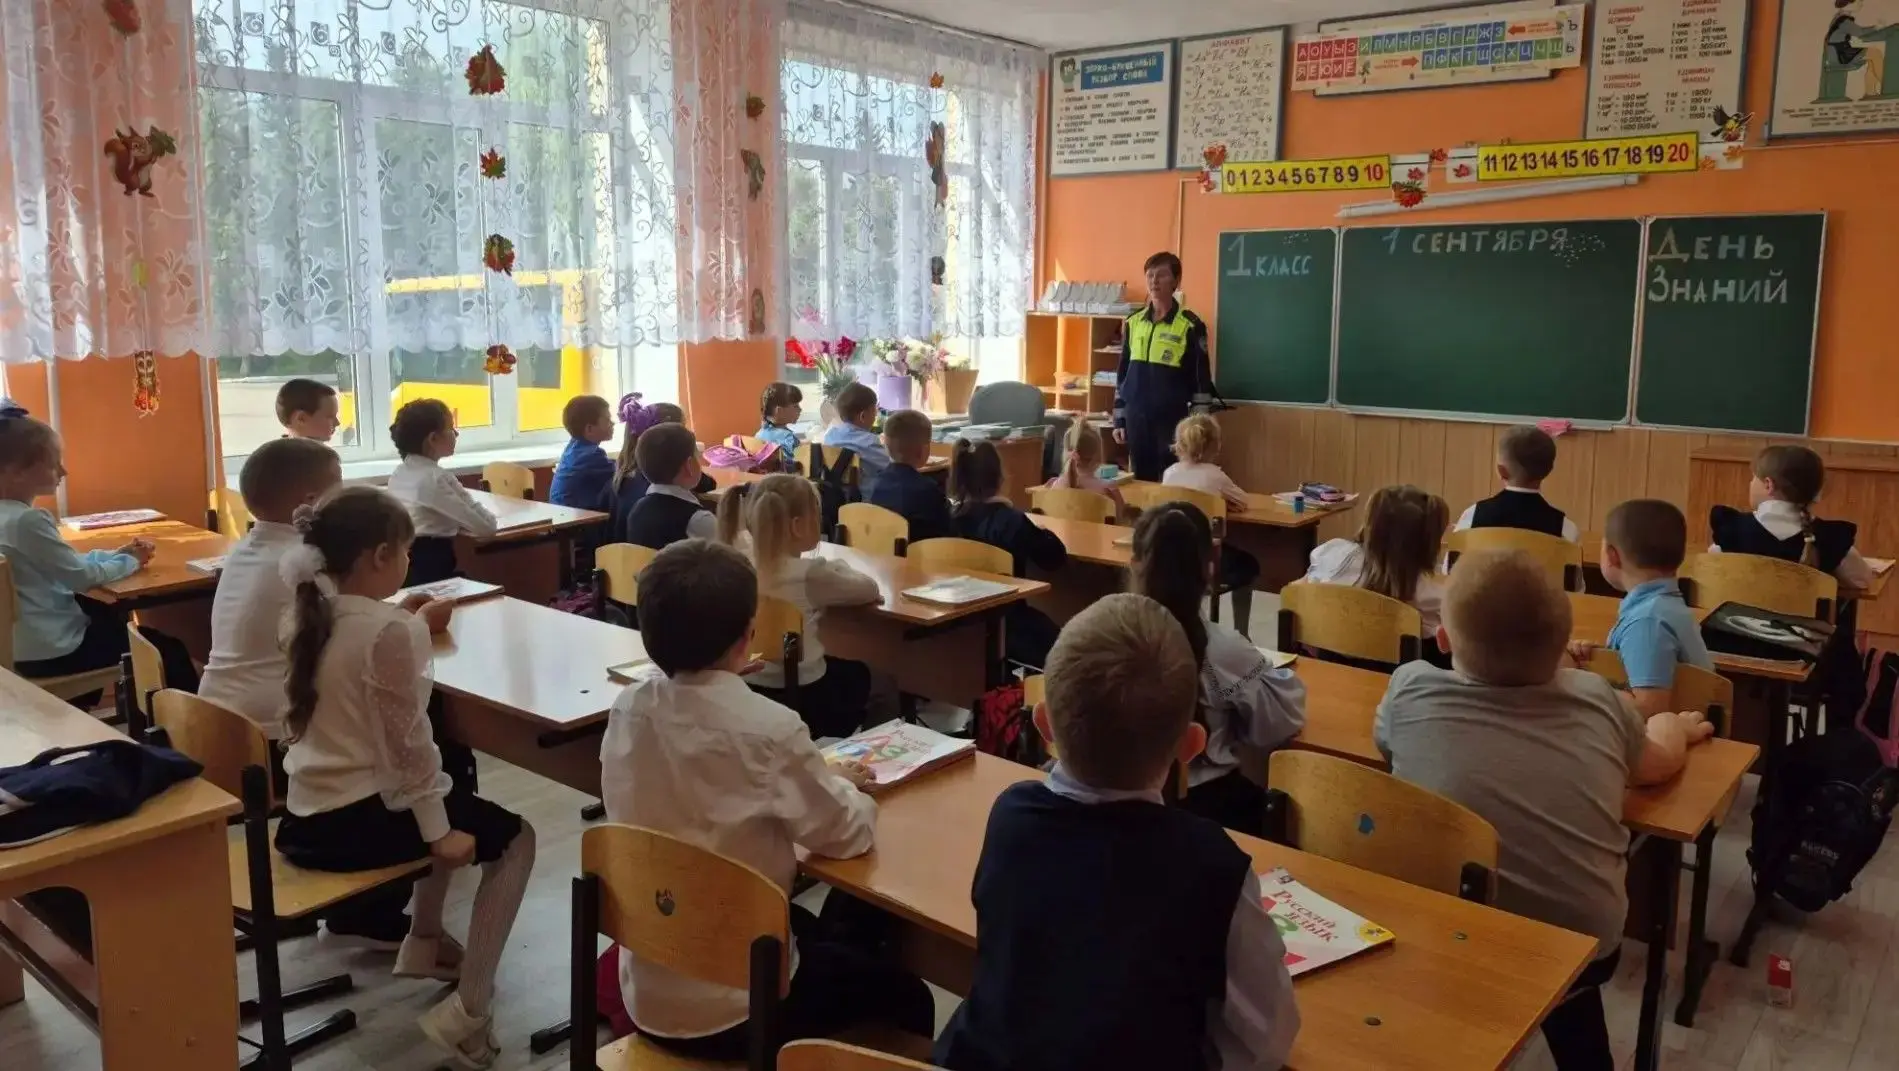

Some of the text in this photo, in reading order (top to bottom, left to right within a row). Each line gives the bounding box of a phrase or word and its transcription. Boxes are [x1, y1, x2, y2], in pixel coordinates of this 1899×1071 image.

[1484, 143, 1688, 172] 11 12 13 14 15 16 17 18 19 20
[1227, 163, 1383, 186] 0 1 2 3 4 5 6 7 8 9 10
[1227, 234, 1312, 276] 1 КЛАСС
[1382, 227, 1568, 255] 1 СЕНТЯБРЯ
[1648, 226, 1775, 263] ДЕНЬ
[1648, 264, 1788, 303] ЗНАНИЙ
